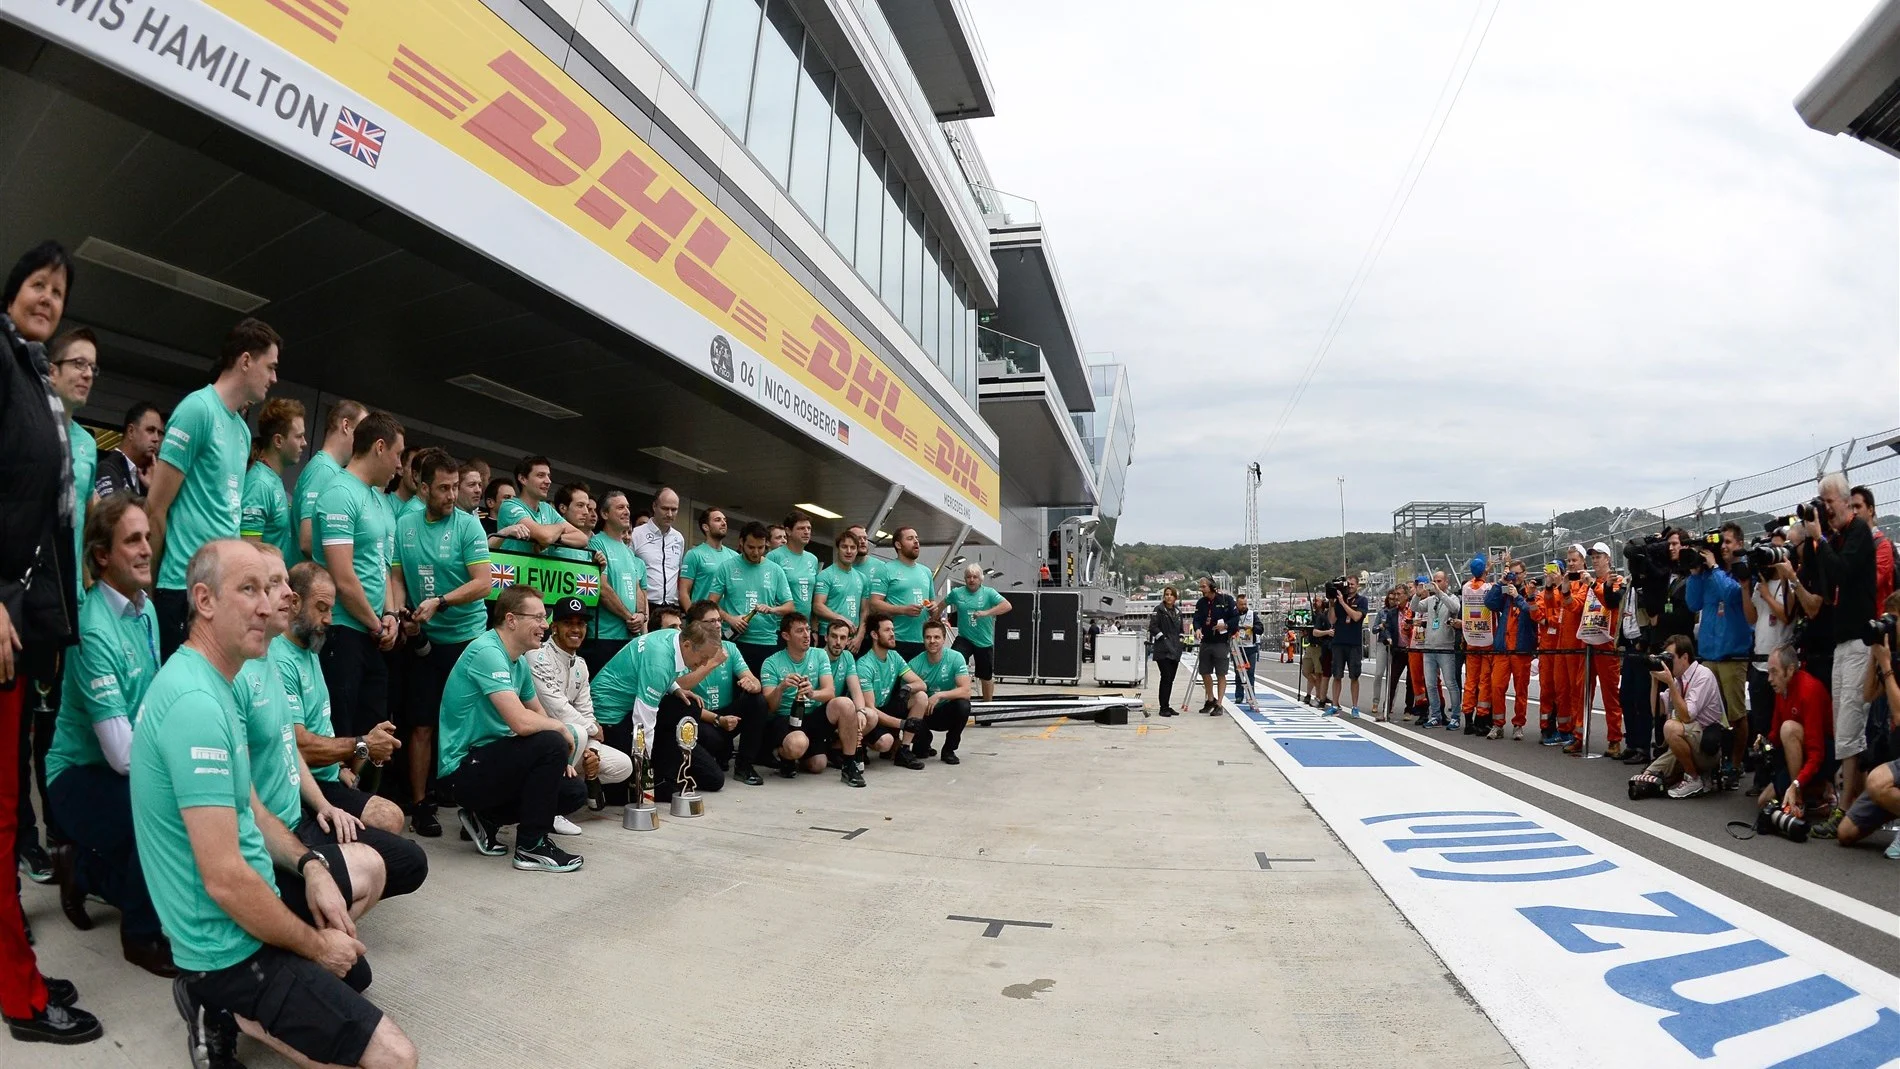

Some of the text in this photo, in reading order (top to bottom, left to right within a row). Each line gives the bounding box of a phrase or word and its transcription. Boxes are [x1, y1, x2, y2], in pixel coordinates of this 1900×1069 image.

[132, 6, 329, 137] HAMILTON
[461, 50, 737, 314] DHL
[740, 361, 837, 437] 06 NICO ROSBERG
[807, 314, 905, 439] DHL
[935, 426, 980, 499] DHL
[943, 493, 963, 515] MERCEDES
[424, 576, 434, 601] 201
[516, 566, 575, 595] LEWIS
